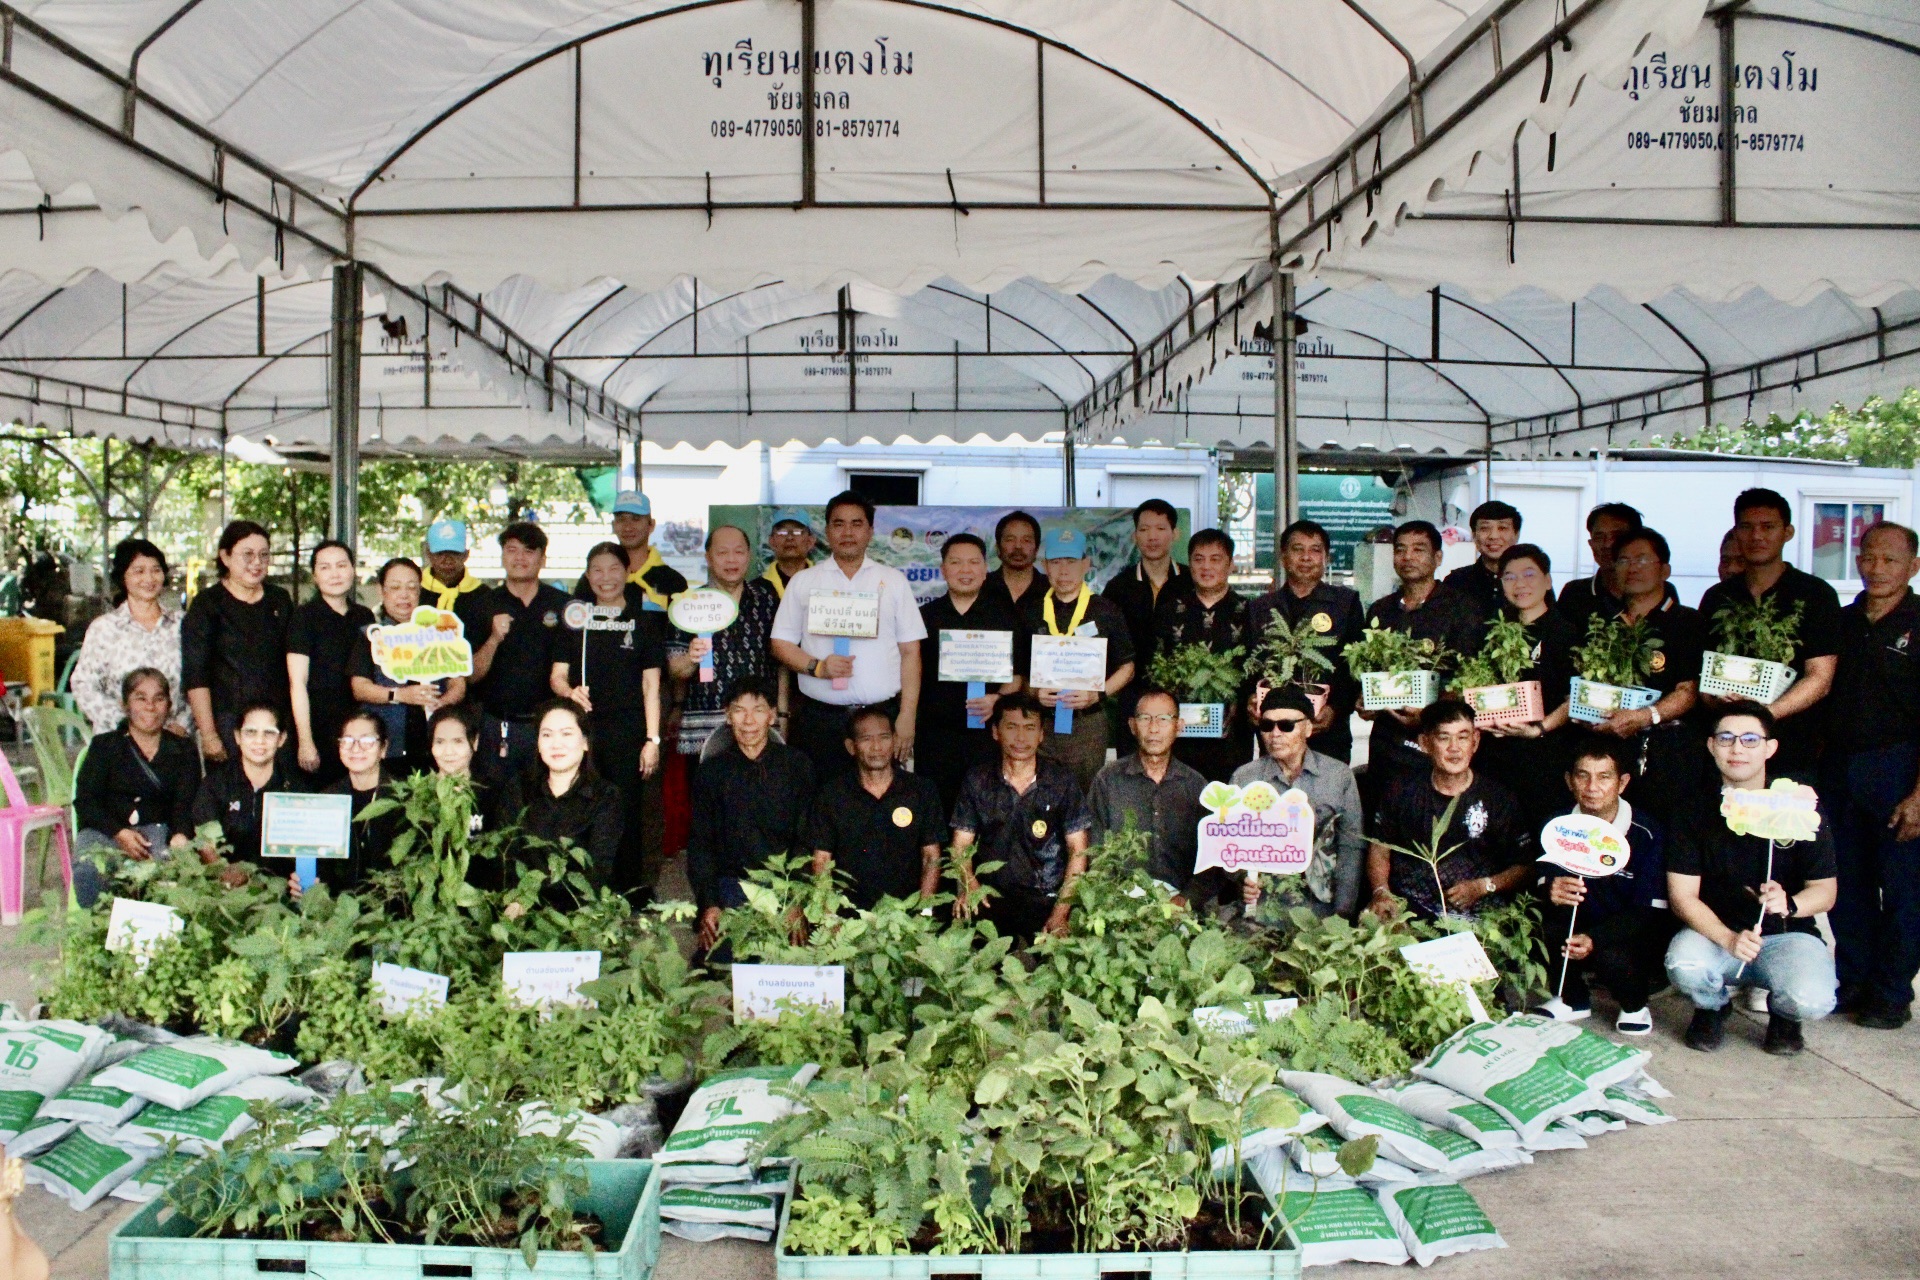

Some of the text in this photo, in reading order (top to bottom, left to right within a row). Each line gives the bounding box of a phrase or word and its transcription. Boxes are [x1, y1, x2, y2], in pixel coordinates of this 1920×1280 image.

[683, 602, 723, 612] Change
[688, 614, 704, 623] for
[758, 978, 816, 988] ตำบลชัยมงคล
